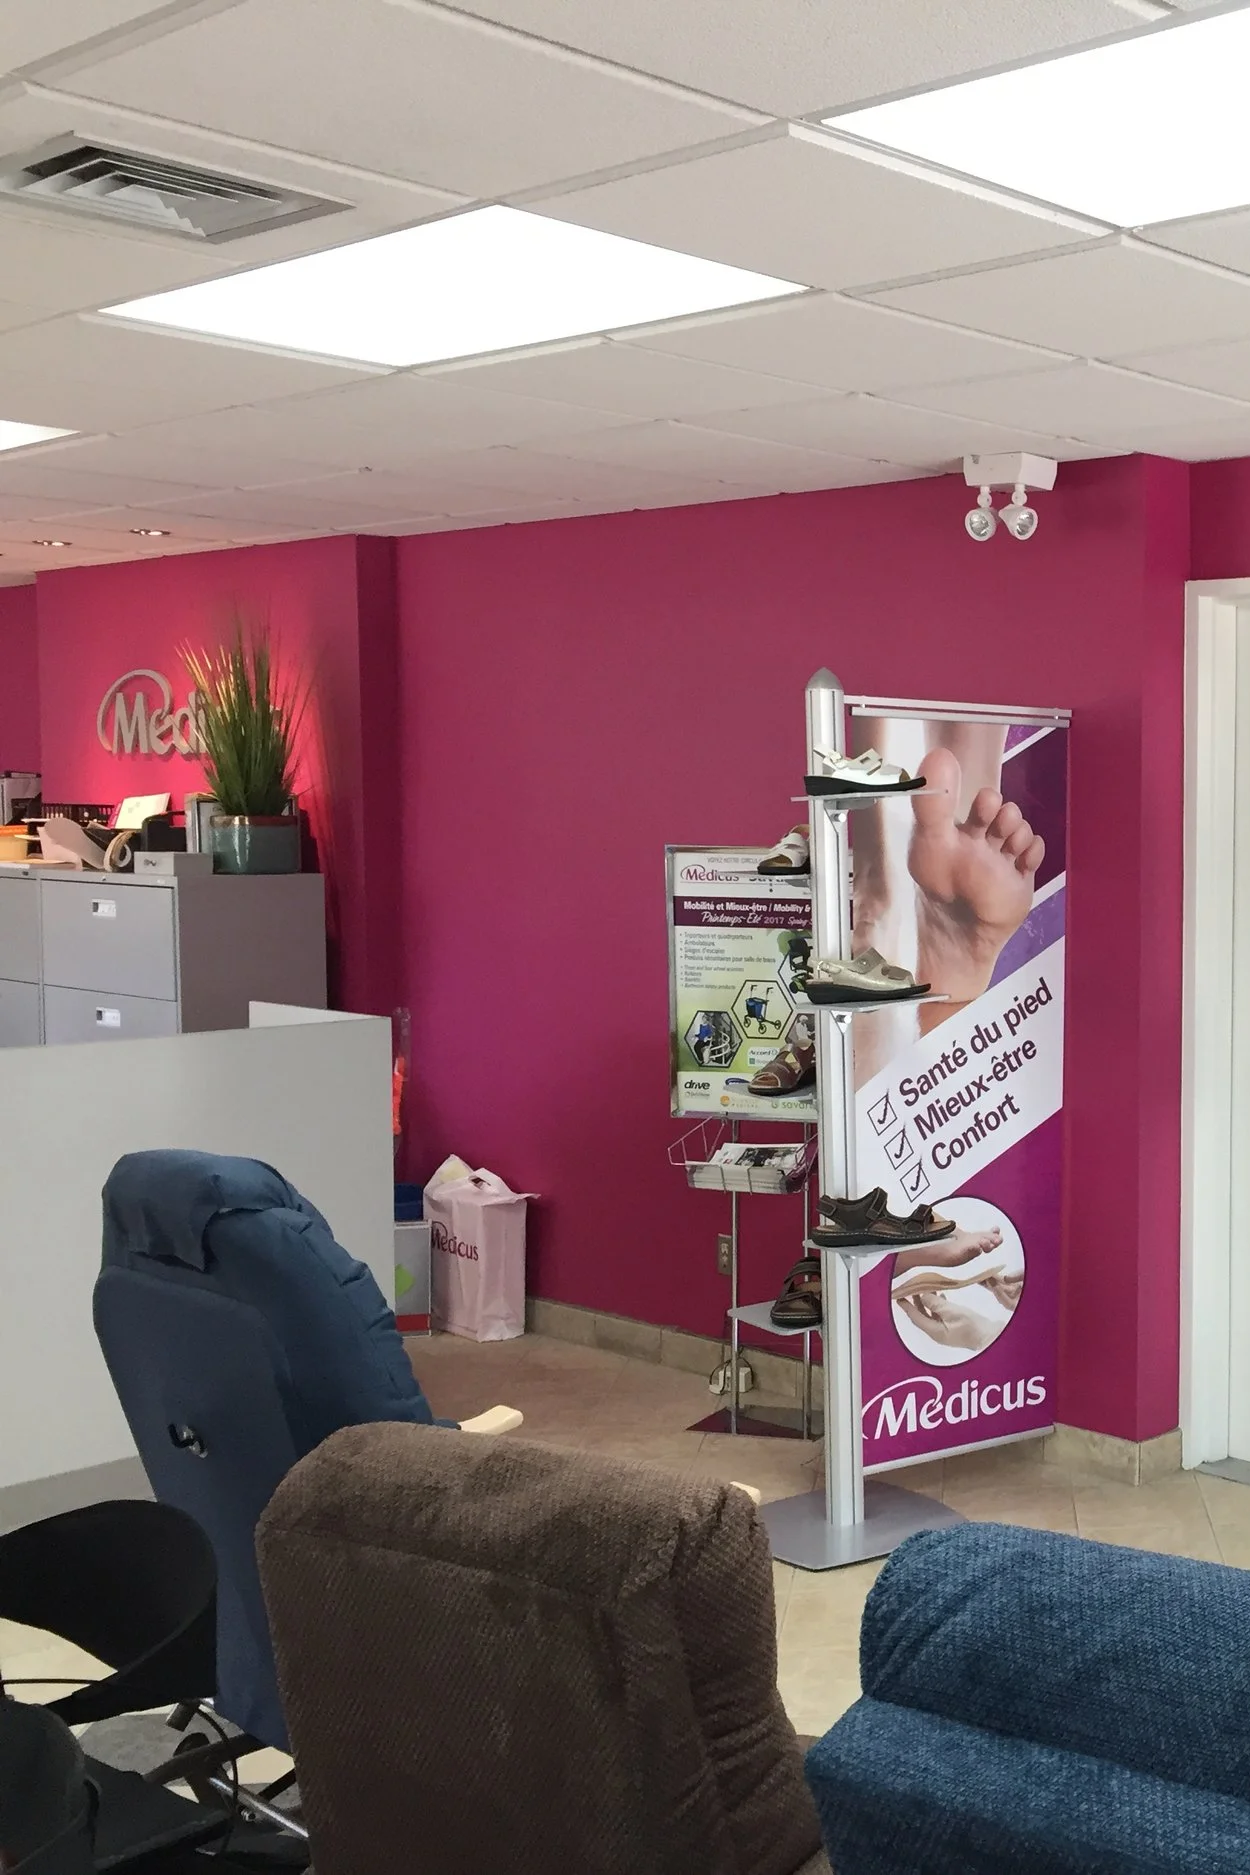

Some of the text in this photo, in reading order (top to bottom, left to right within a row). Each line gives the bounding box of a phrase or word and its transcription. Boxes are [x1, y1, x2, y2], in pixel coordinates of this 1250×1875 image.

[683, 901, 714, 910] Mobilité
[716, 902, 724, 910] et
[725, 902, 767, 912] Mieux-être
[773, 903, 804, 914] Mobility
[764, 916, 784, 924] 2017
[898, 976, 1054, 1107] Santé du pied
[684, 1079, 711, 1090] drive
[913, 1038, 1038, 1141] Mieux-être
[930, 1092, 1021, 1170] Confort
[861, 1375, 1047, 1441] Medicus
